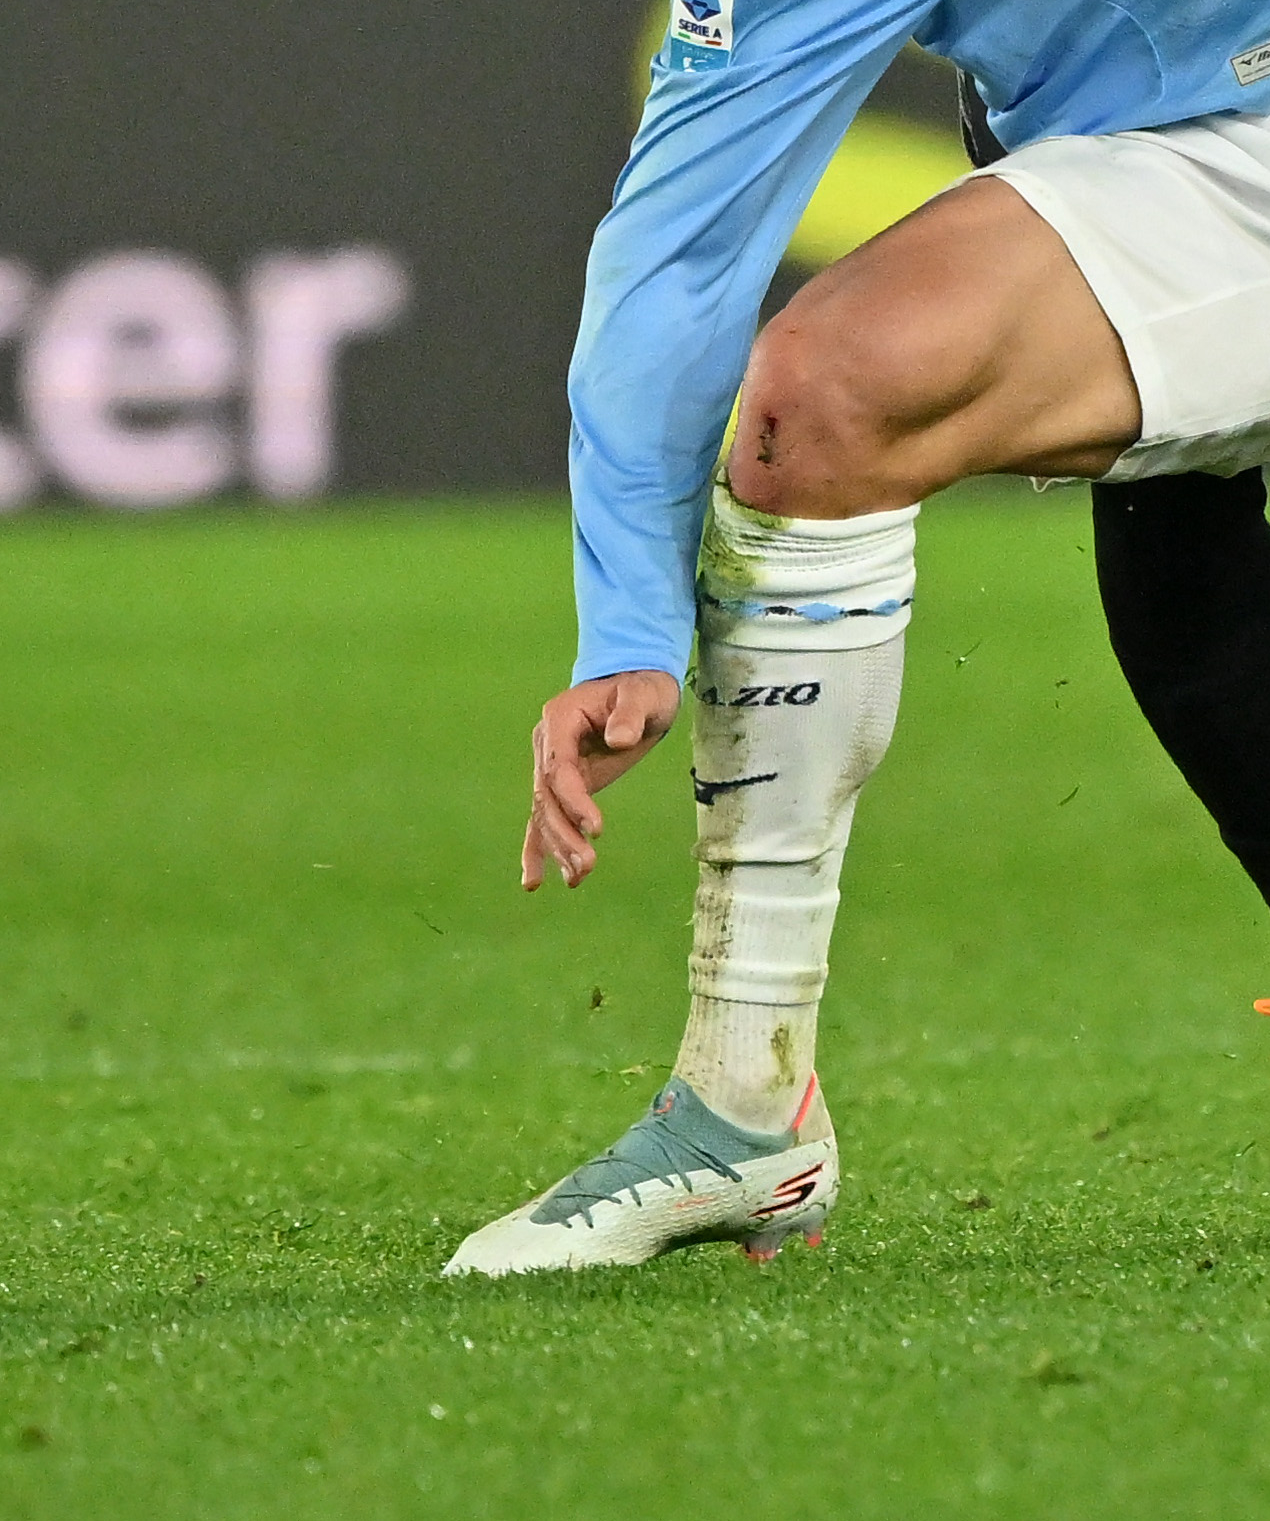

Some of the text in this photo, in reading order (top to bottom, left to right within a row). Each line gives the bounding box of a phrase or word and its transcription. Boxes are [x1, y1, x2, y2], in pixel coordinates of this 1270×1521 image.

[678, 18, 723, 40] SERIE A
[0, 246, 408, 508] er
[701, 681, 821, 707] AZIO
